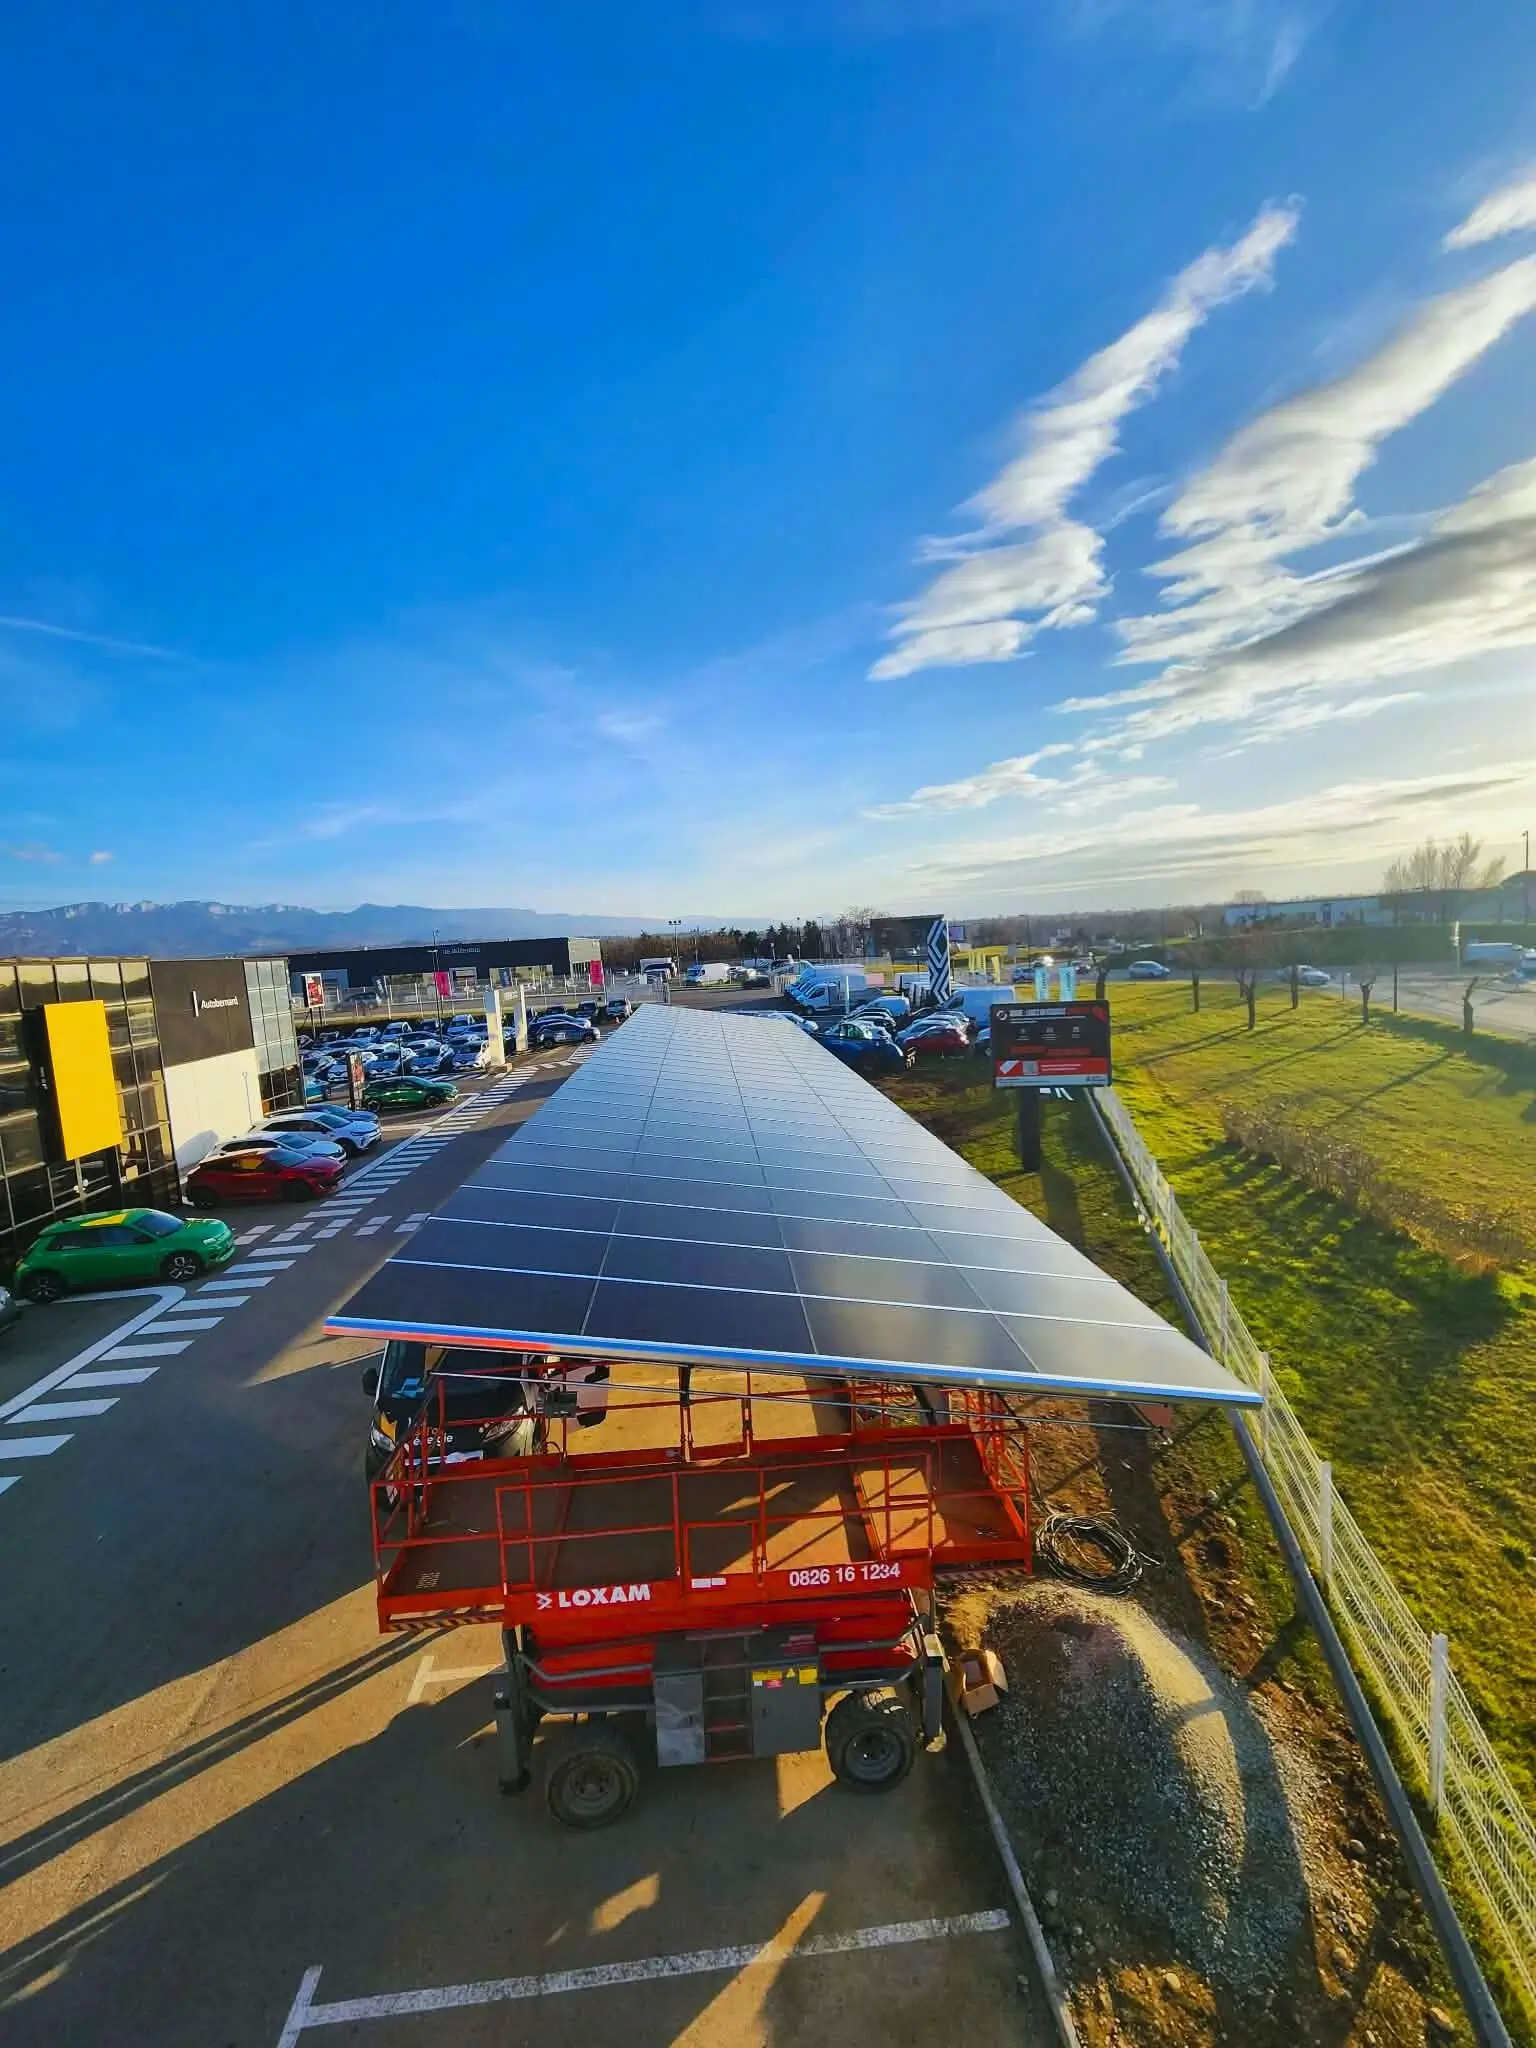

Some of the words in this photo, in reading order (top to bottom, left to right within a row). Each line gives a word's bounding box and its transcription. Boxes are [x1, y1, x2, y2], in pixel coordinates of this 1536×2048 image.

[789, 1569, 830, 1586] 0826
[836, 1567, 855, 1582] 16
[861, 1563, 900, 1580] 1234
[558, 1583, 651, 1608] LOXAM
